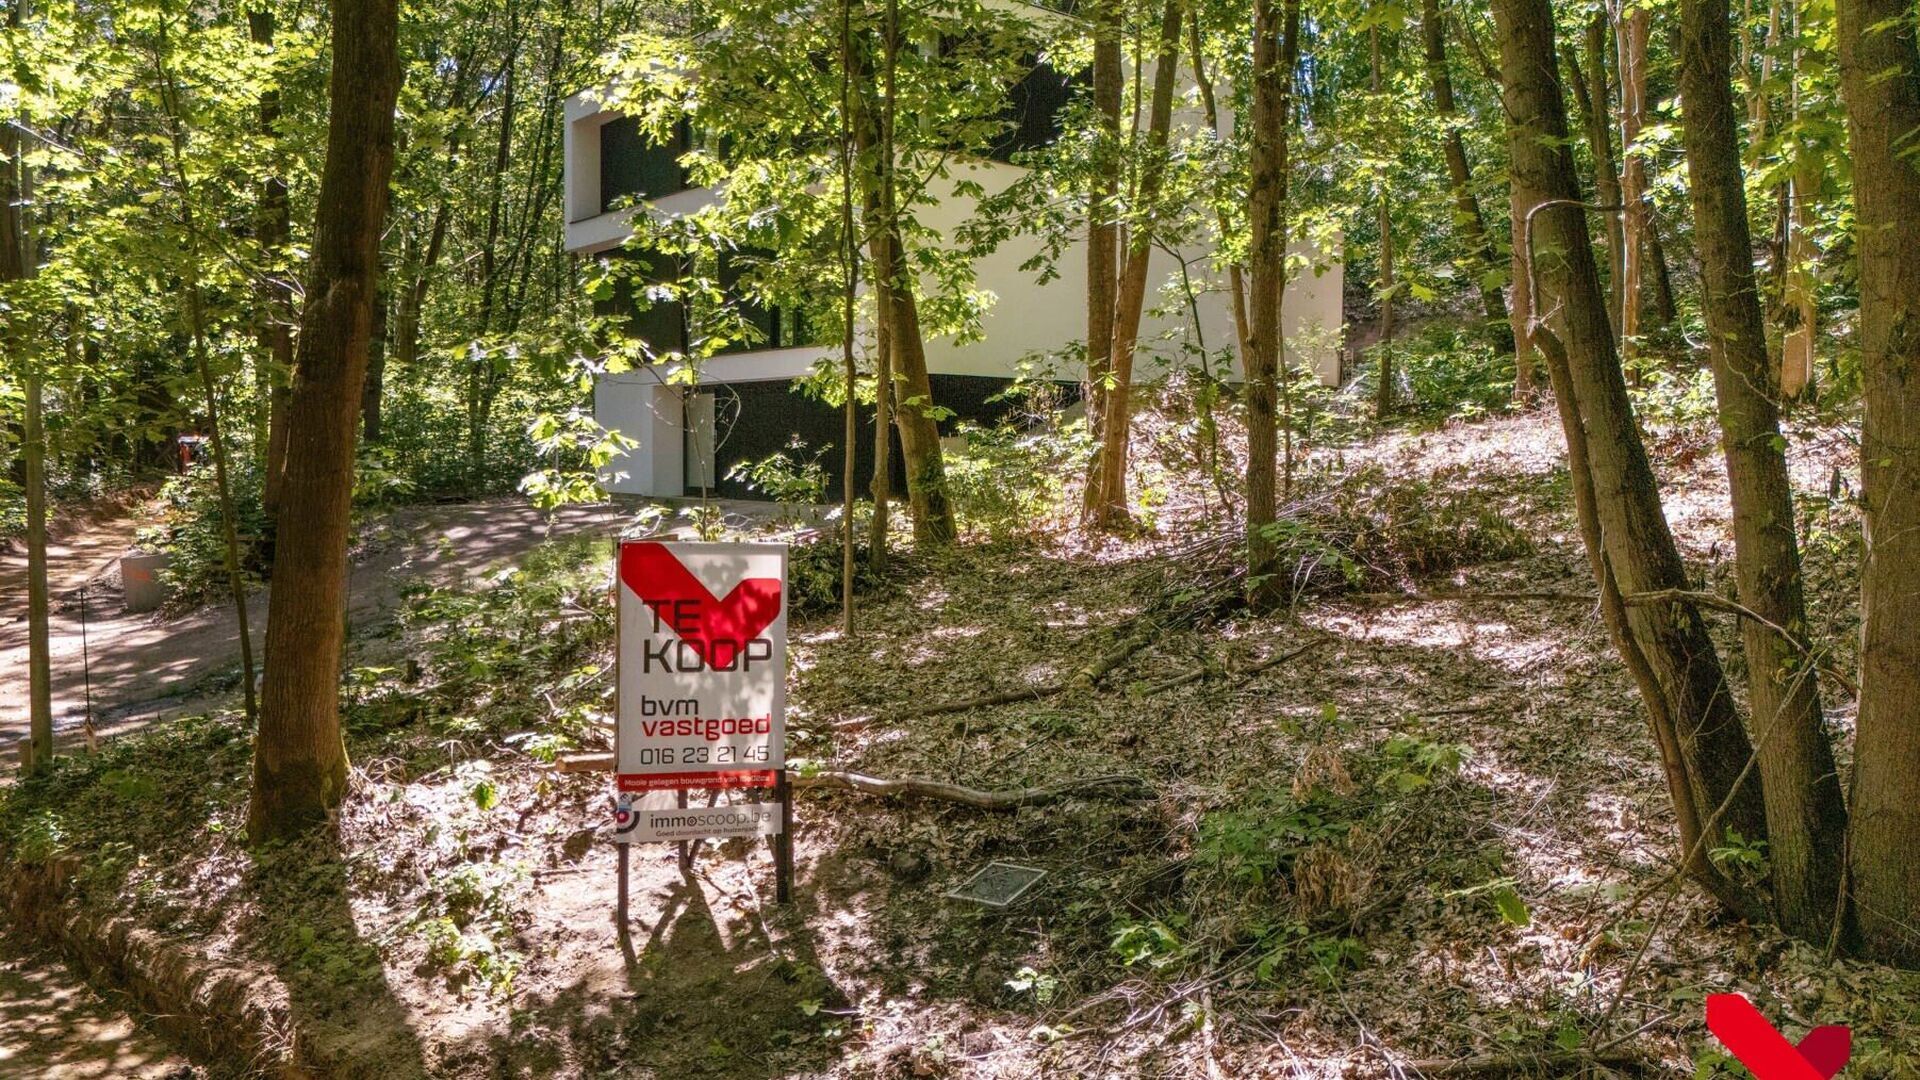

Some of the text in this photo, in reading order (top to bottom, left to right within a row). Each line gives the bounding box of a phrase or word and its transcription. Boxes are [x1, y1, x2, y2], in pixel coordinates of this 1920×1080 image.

[643, 600, 702, 633] TE
[643, 639, 772, 673] KOOP
[641, 695, 699, 716] bvm
[642, 713, 771, 741] vastgoed
[640, 745, 770, 765] 016 23 21 45
[649, 778, 679, 787] gelegen
